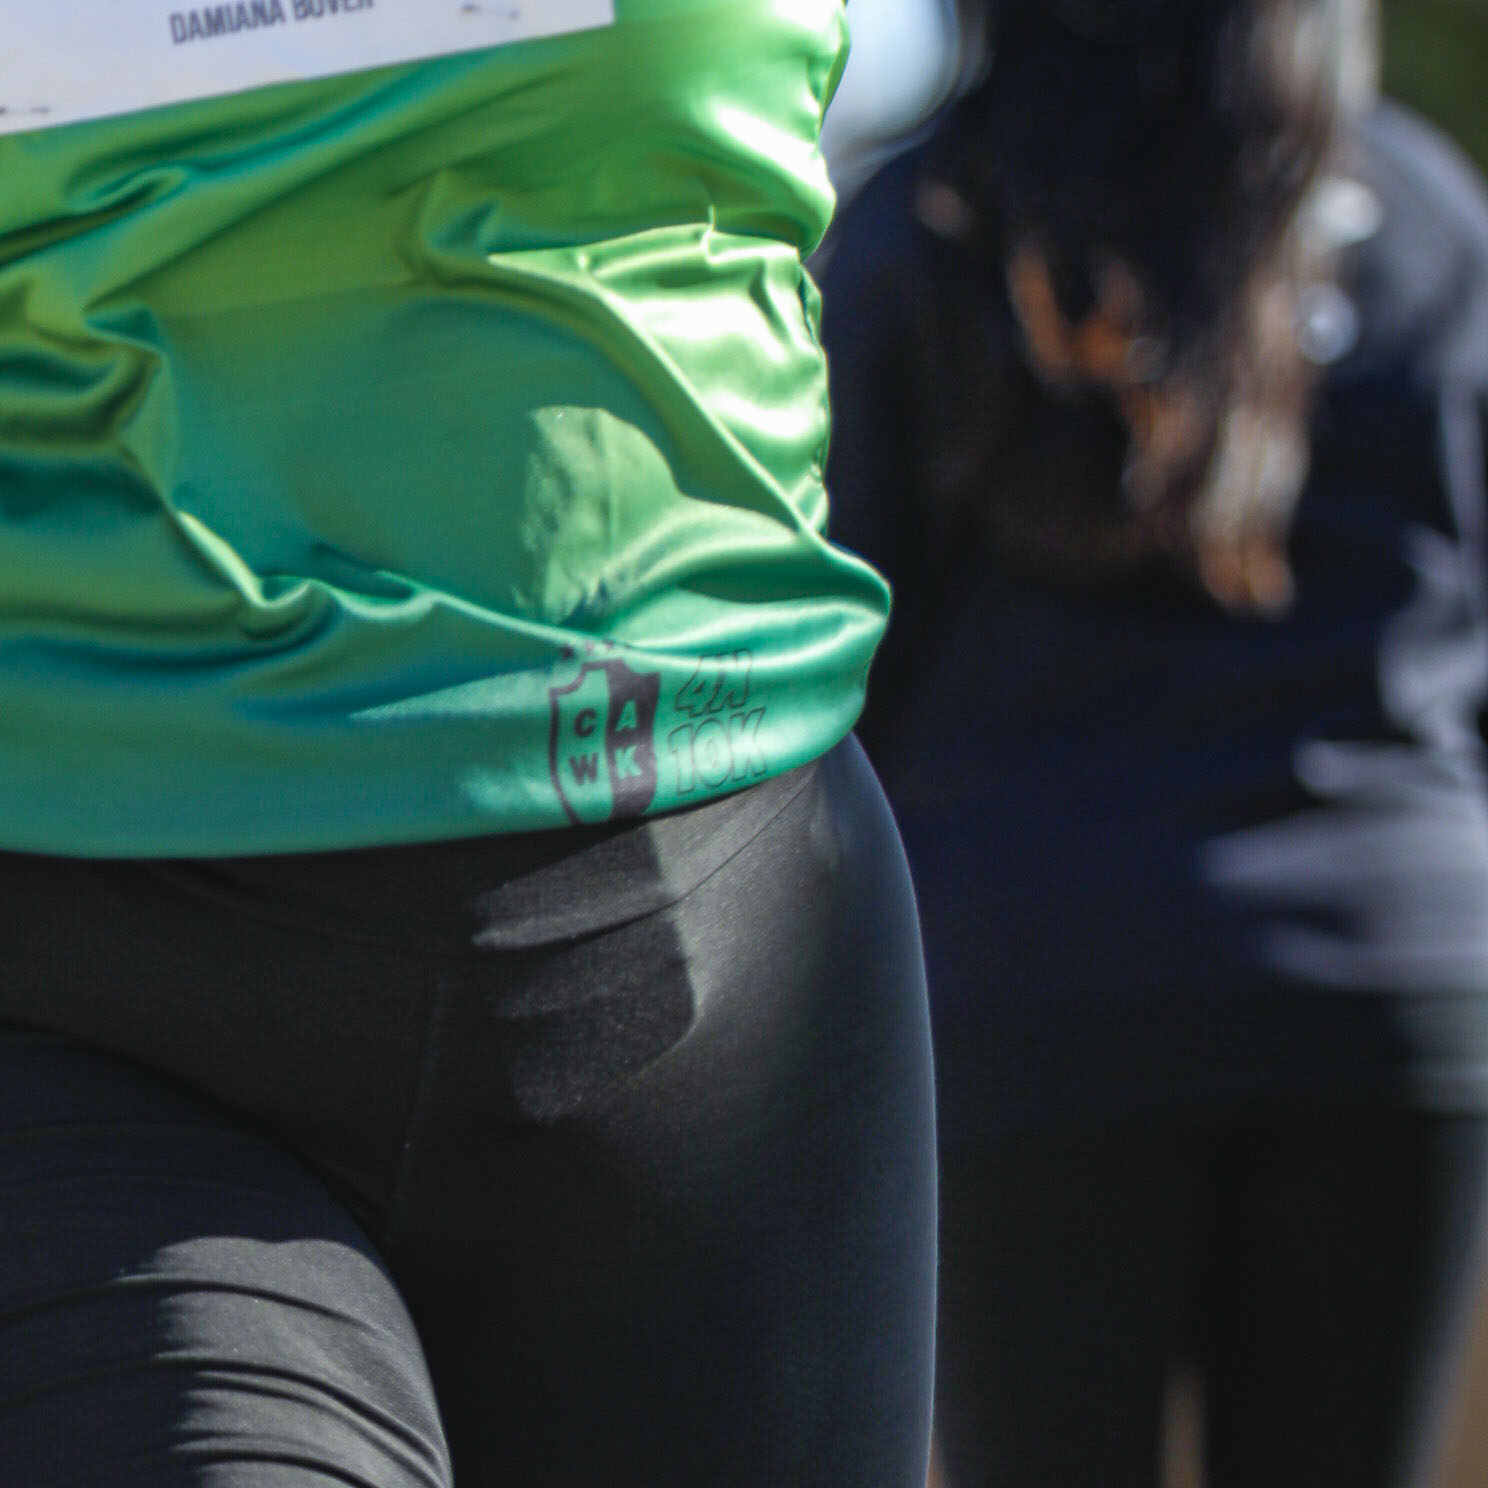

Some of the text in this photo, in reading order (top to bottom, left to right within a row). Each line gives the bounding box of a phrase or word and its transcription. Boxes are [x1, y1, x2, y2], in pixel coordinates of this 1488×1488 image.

[573, 698, 639, 738] C A
[569, 744, 643, 786] W K
[667, 706, 767, 795] 10K
